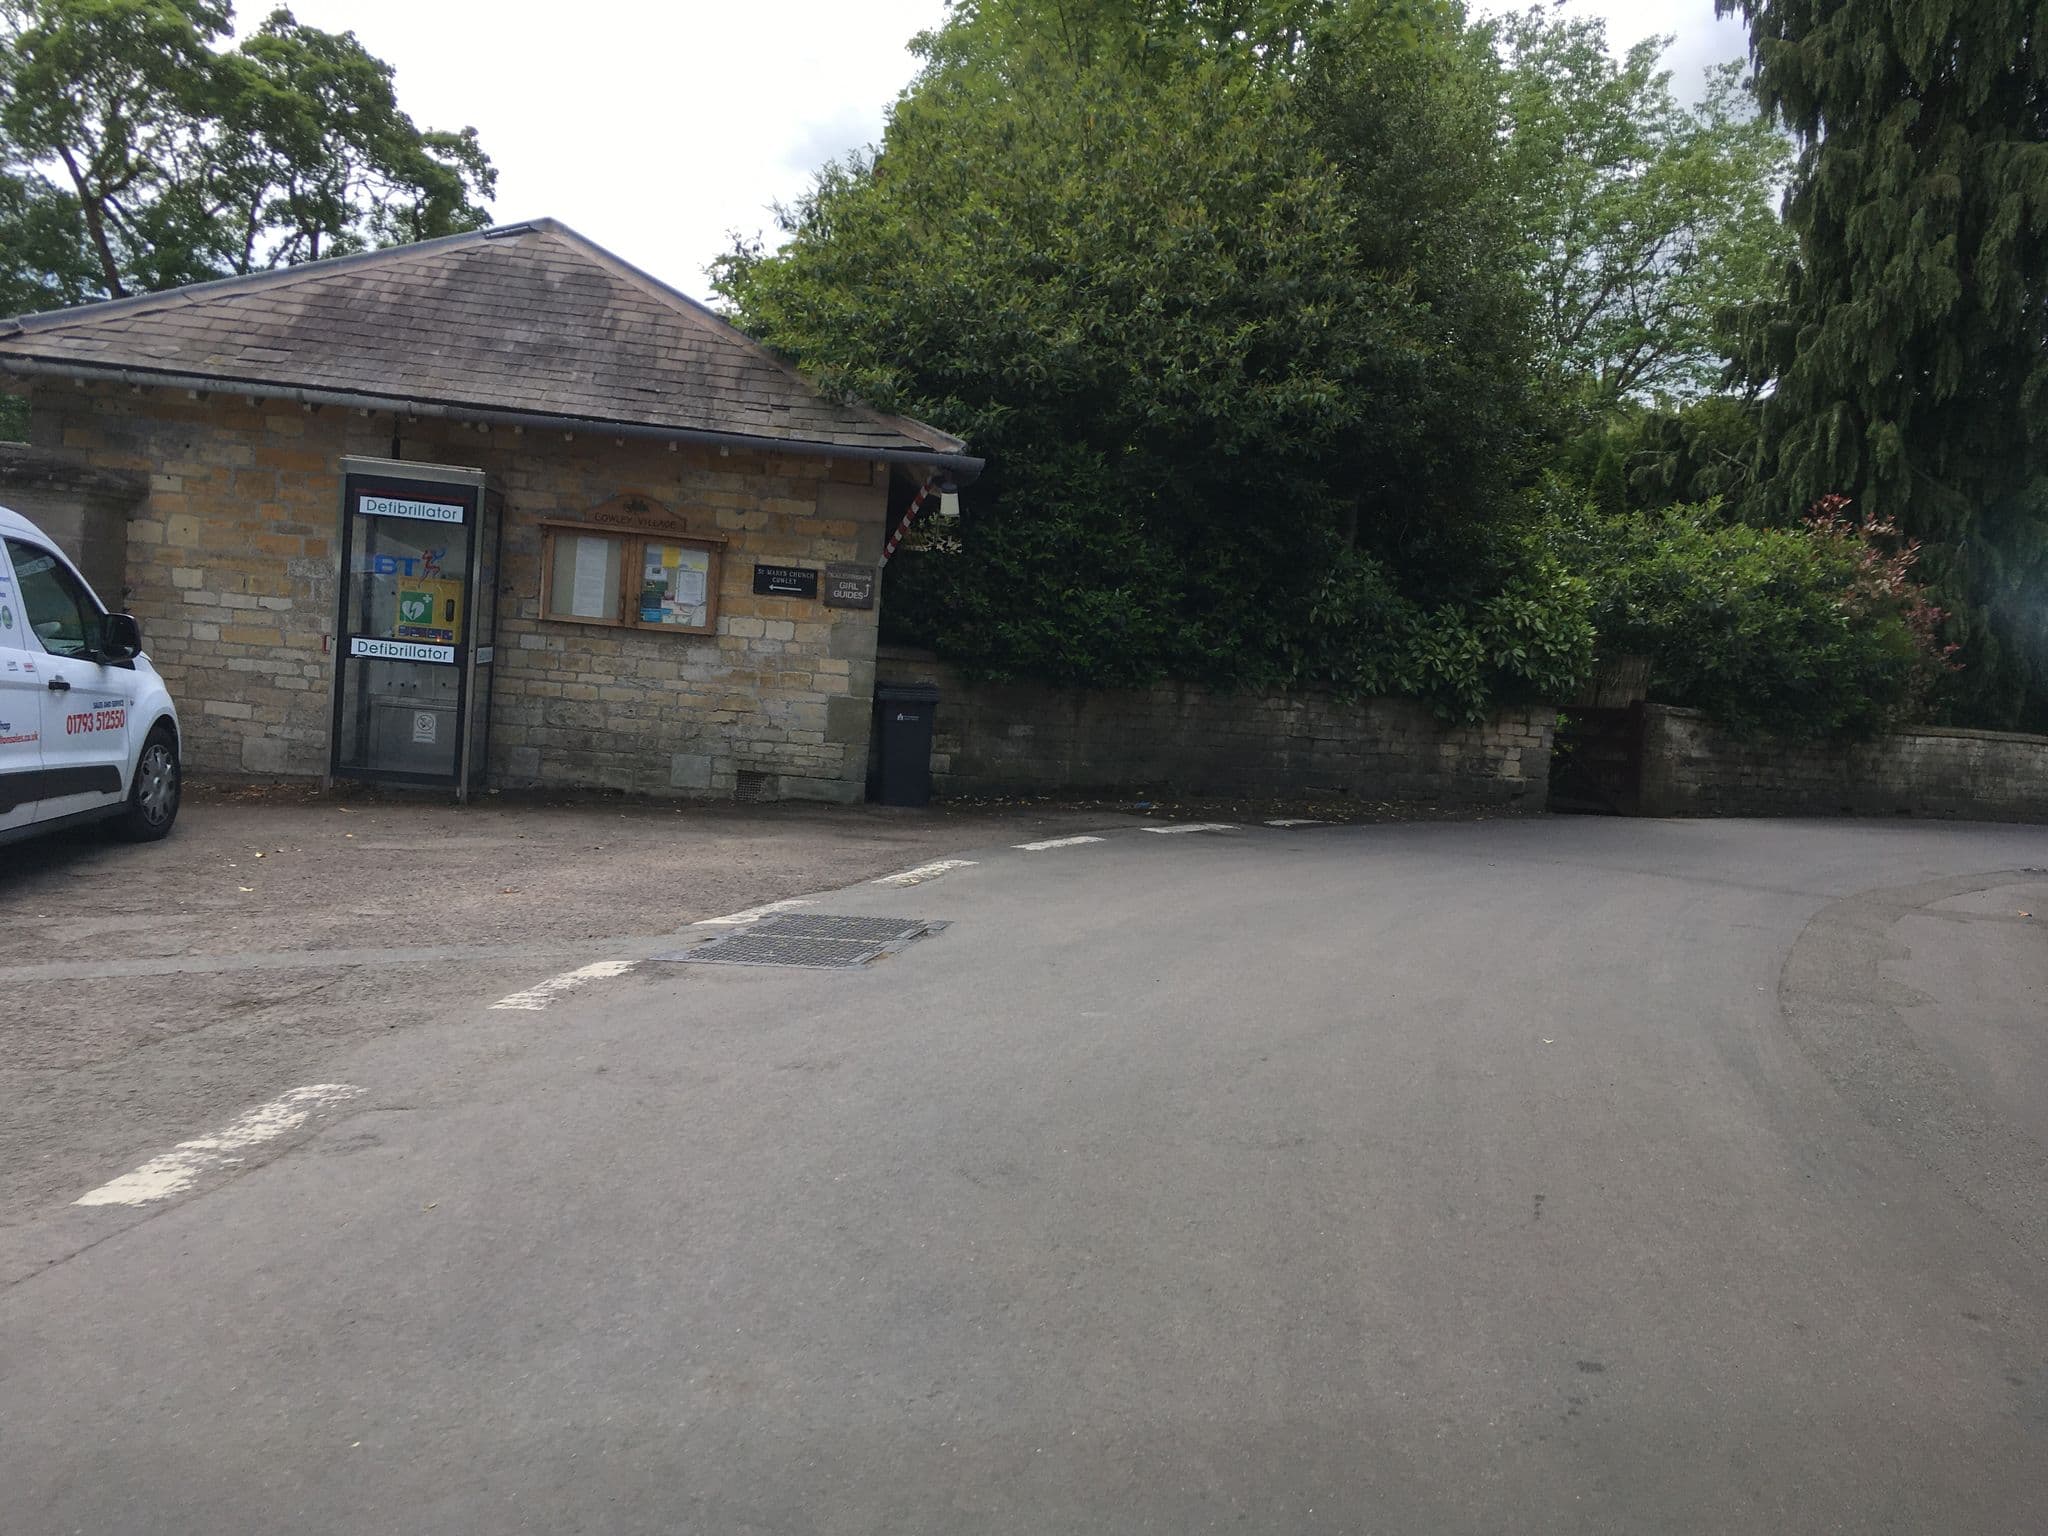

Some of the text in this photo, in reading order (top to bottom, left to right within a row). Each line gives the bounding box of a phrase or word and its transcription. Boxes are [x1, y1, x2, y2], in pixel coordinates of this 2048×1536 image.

[366, 499, 458, 521] Defibrillator
[594, 512, 677, 530] COWLEY VILLAGE
[375, 555, 421, 576] BT
[772, 577, 797, 585] COWLEY
[789, 571, 815, 580] CHURCH
[839, 581, 859, 590] GIRL
[833, 590, 864, 600] GUIDES
[357, 640, 449, 662] Defibrillator
[67, 710, 125, 735] 01793 512550
